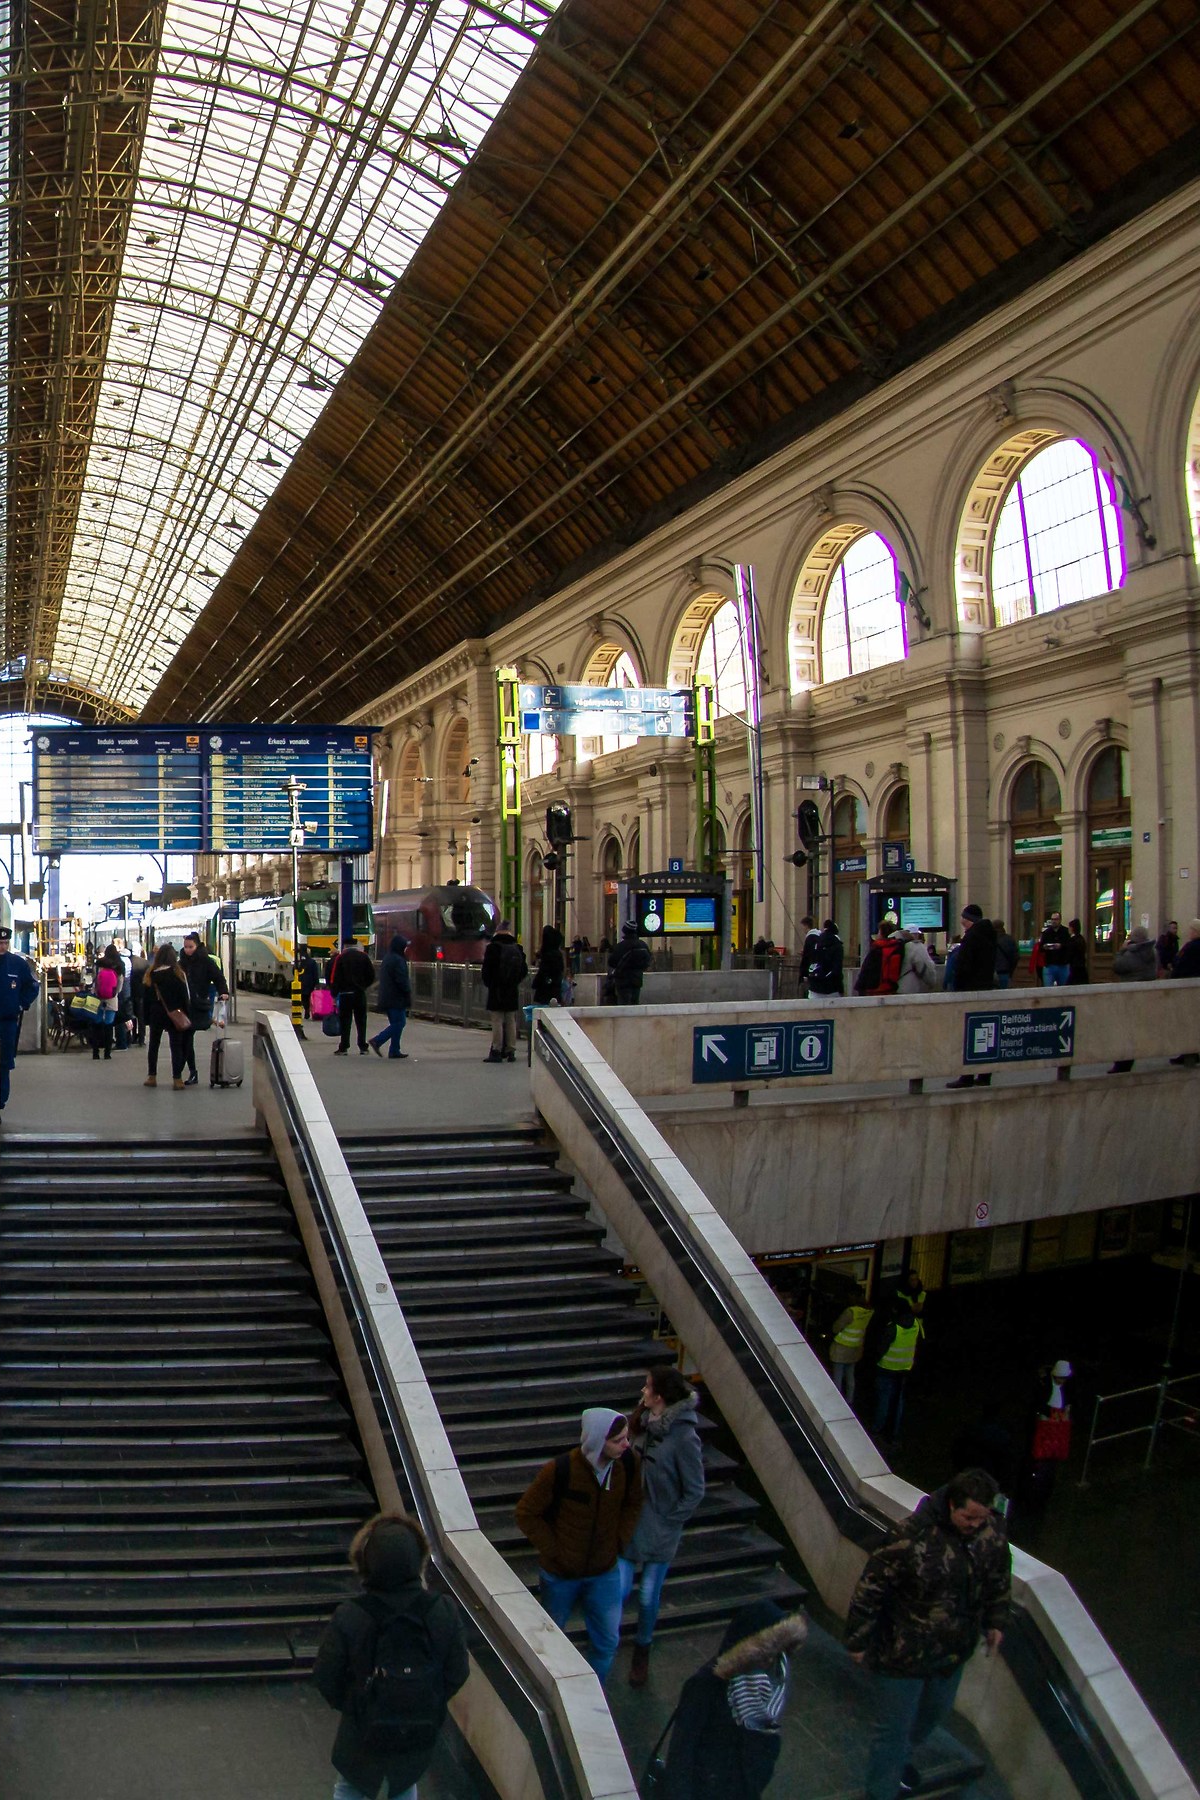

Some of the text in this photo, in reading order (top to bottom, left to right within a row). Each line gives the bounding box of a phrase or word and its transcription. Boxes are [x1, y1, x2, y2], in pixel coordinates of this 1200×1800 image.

[629, 695, 639, 707] 9
[655, 696, 670, 708] 13
[672, 861, 679, 871] 8
[905, 862, 912, 872] 9
[648, 899, 657, 912] 8
[887, 897, 895, 910] 9
[1001, 1014, 1031, 1024] Belföldi
[1001, 1023, 1057, 1036] Jegypénztárak
[1000, 1038, 1023, 1047] Inland
[1000, 1047, 1053, 1058] Ticket Offices
